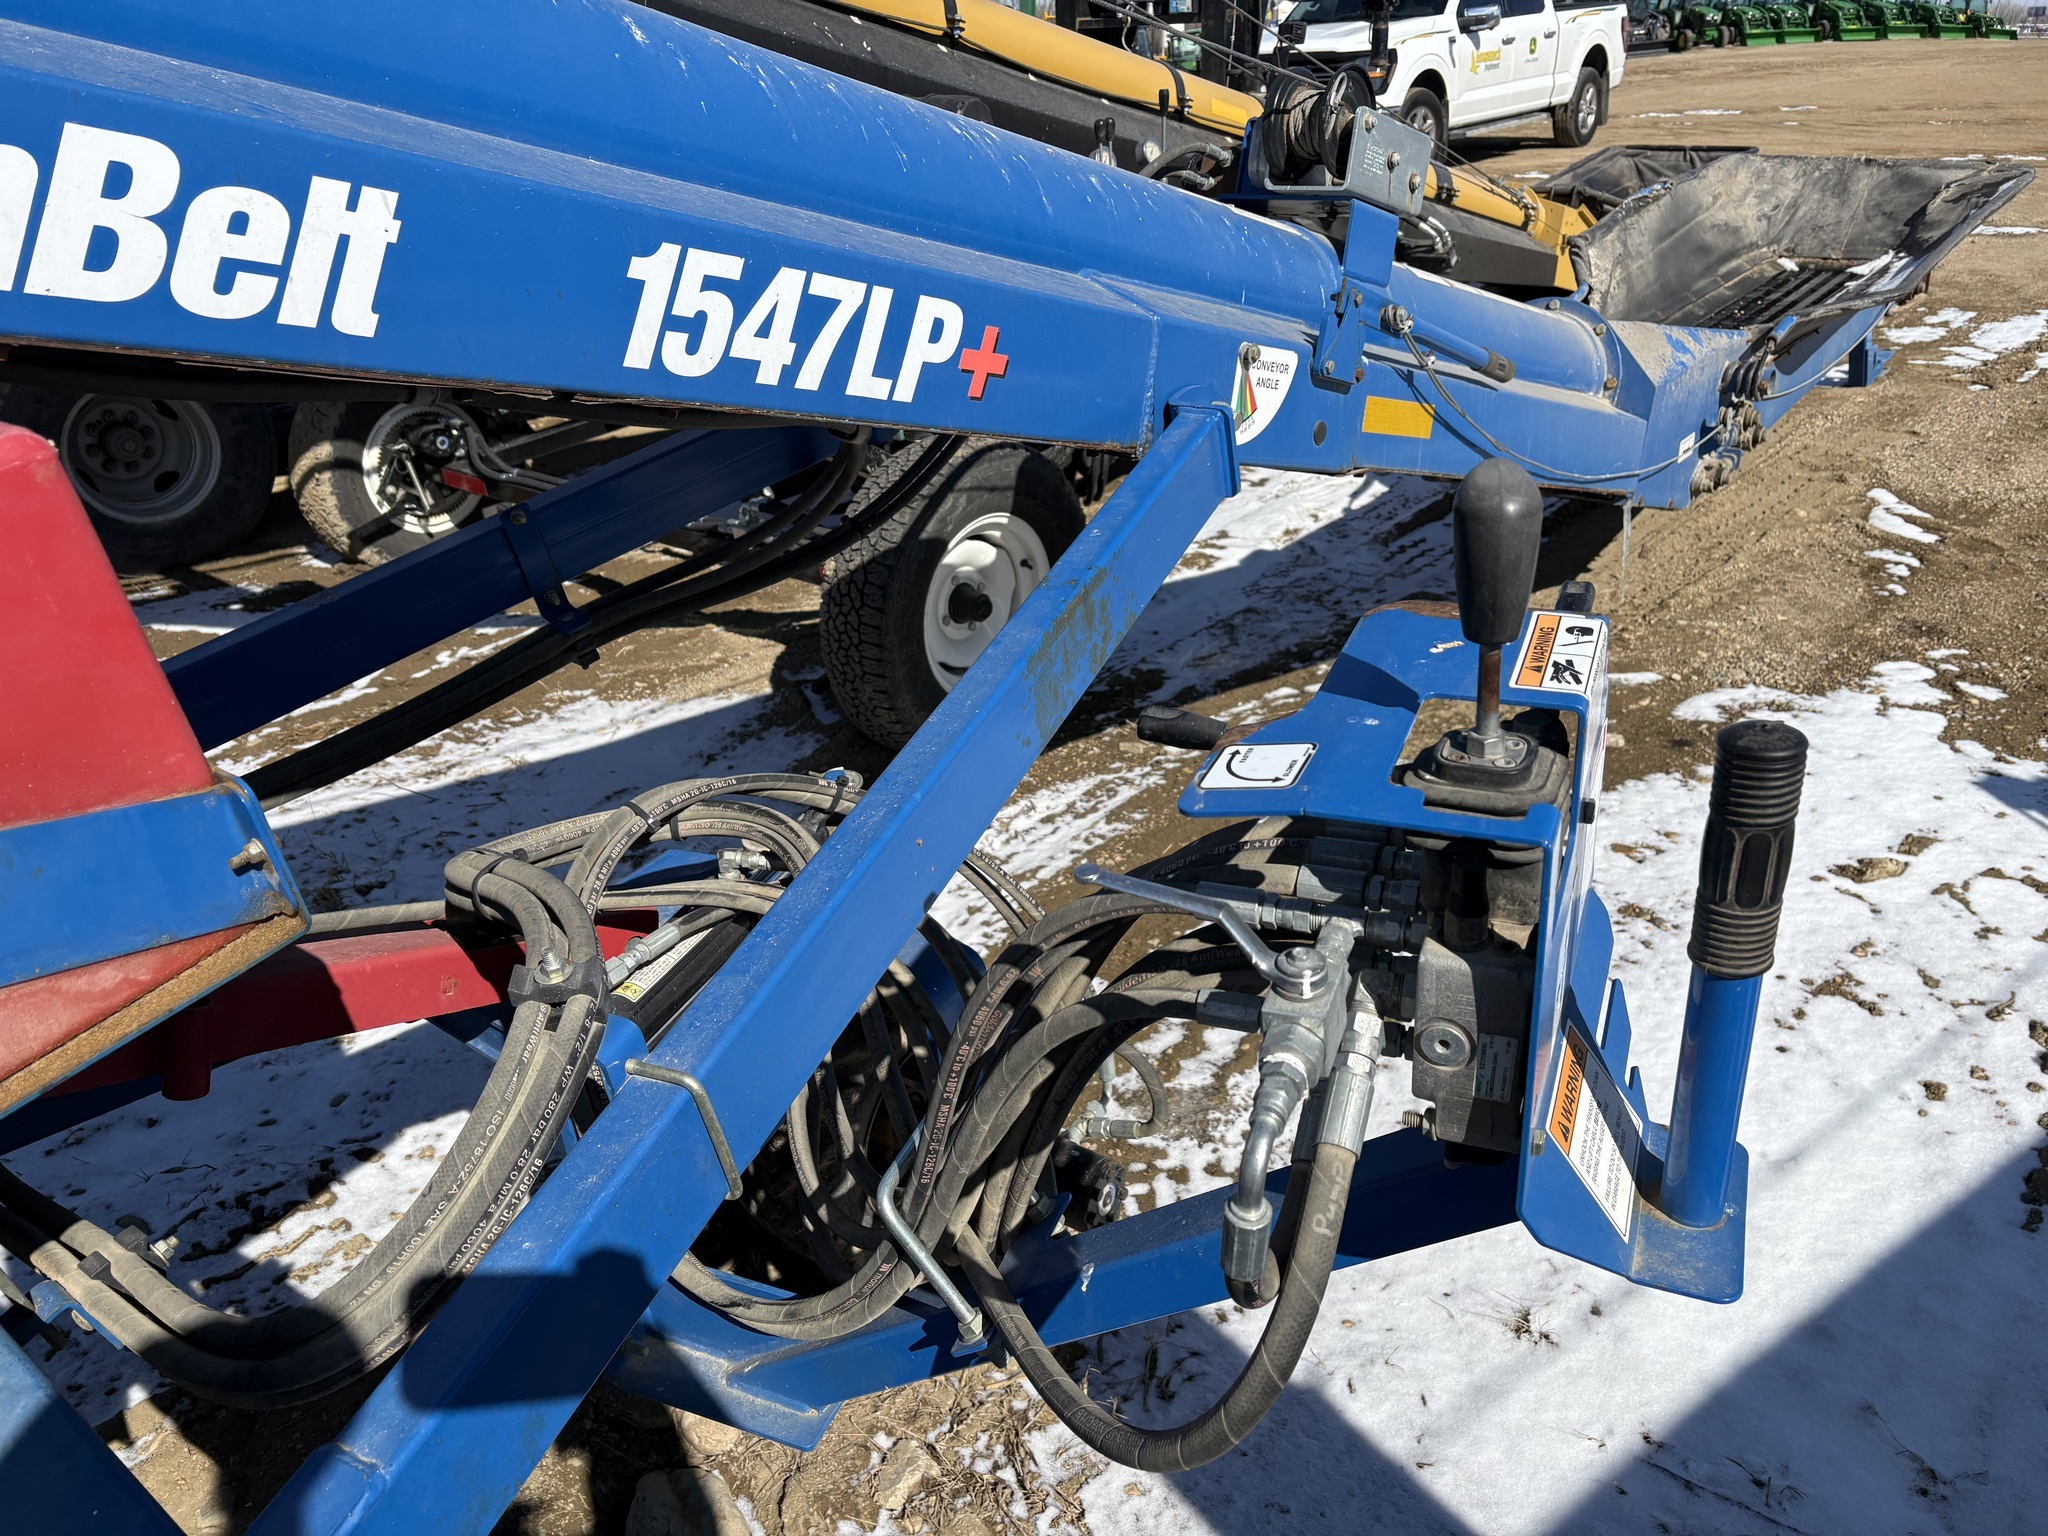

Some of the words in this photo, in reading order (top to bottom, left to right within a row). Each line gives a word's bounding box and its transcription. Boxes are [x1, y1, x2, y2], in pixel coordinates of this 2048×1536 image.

[1255, 376, 1280, 390] ANGLE
[1529, 627, 1555, 663] WARNING
[1239, 747, 1254, 763] FASTER
[1282, 759, 1299, 777] SLOWER
[670, 792, 691, 806] MSHA
[972, 848, 981, 857] SO
[972, 1005, 991, 1026] 4060
[521, 1011, 546, 1064] AntiWear
[561, 1064, 574, 1089] WP
[1561, 1043, 1584, 1124] WARNING
[543, 1091, 561, 1120] 280
[936, 1104, 951, 1128] MSHA
[486, 1109, 505, 1137] ISO
[531, 1119, 548, 1144] bar
[448, 1140, 488, 1195] 18752-A
[509, 1148, 533, 1180] 28.0
[1604, 1172, 1612, 1203] FAILURE
[424, 1200, 449, 1229] SAE
[461, 1219, 488, 1252] 4060
[386, 1230, 427, 1275] 100R19
[448, 1252, 463, 1270] psi
[461, 1243, 491, 1275] MSHA
